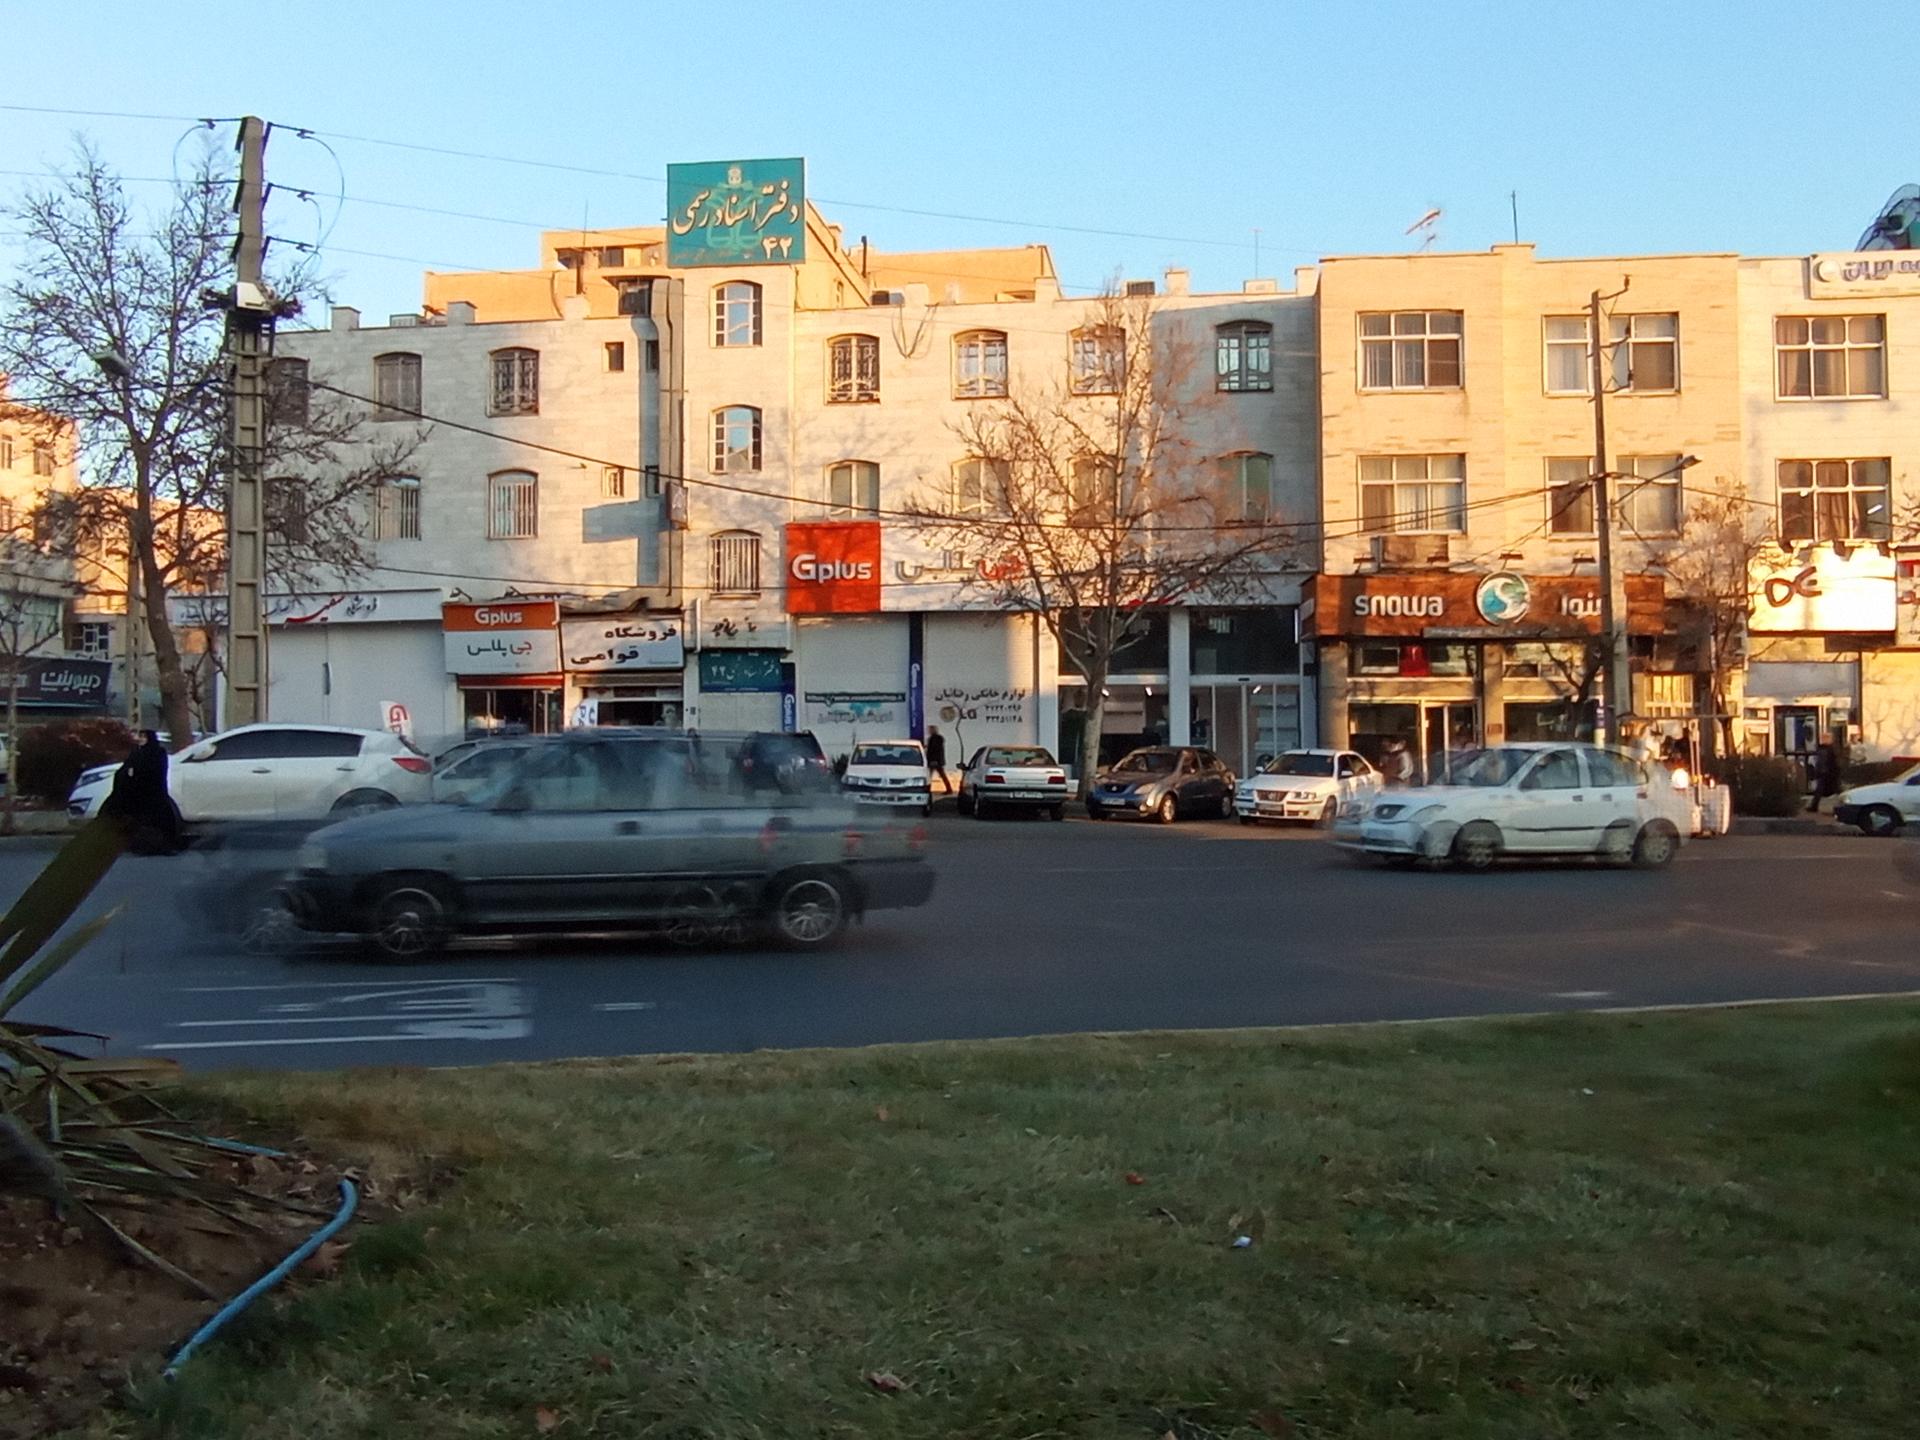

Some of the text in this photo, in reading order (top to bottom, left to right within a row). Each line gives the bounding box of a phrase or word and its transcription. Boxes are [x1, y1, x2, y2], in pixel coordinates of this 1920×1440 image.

[672, 180, 799, 235] دفتر اسناد رسمی
[761, 236, 793, 260] ۴۲
[792, 554, 873, 584] Gplus
[474, 608, 524, 627] Gplus
[604, 624, 677, 641] فروشگاه
[466, 638, 533, 658] جی پلاس
[571, 646, 639, 665] قوامی
[970, 687, 1000, 701] خانگی
